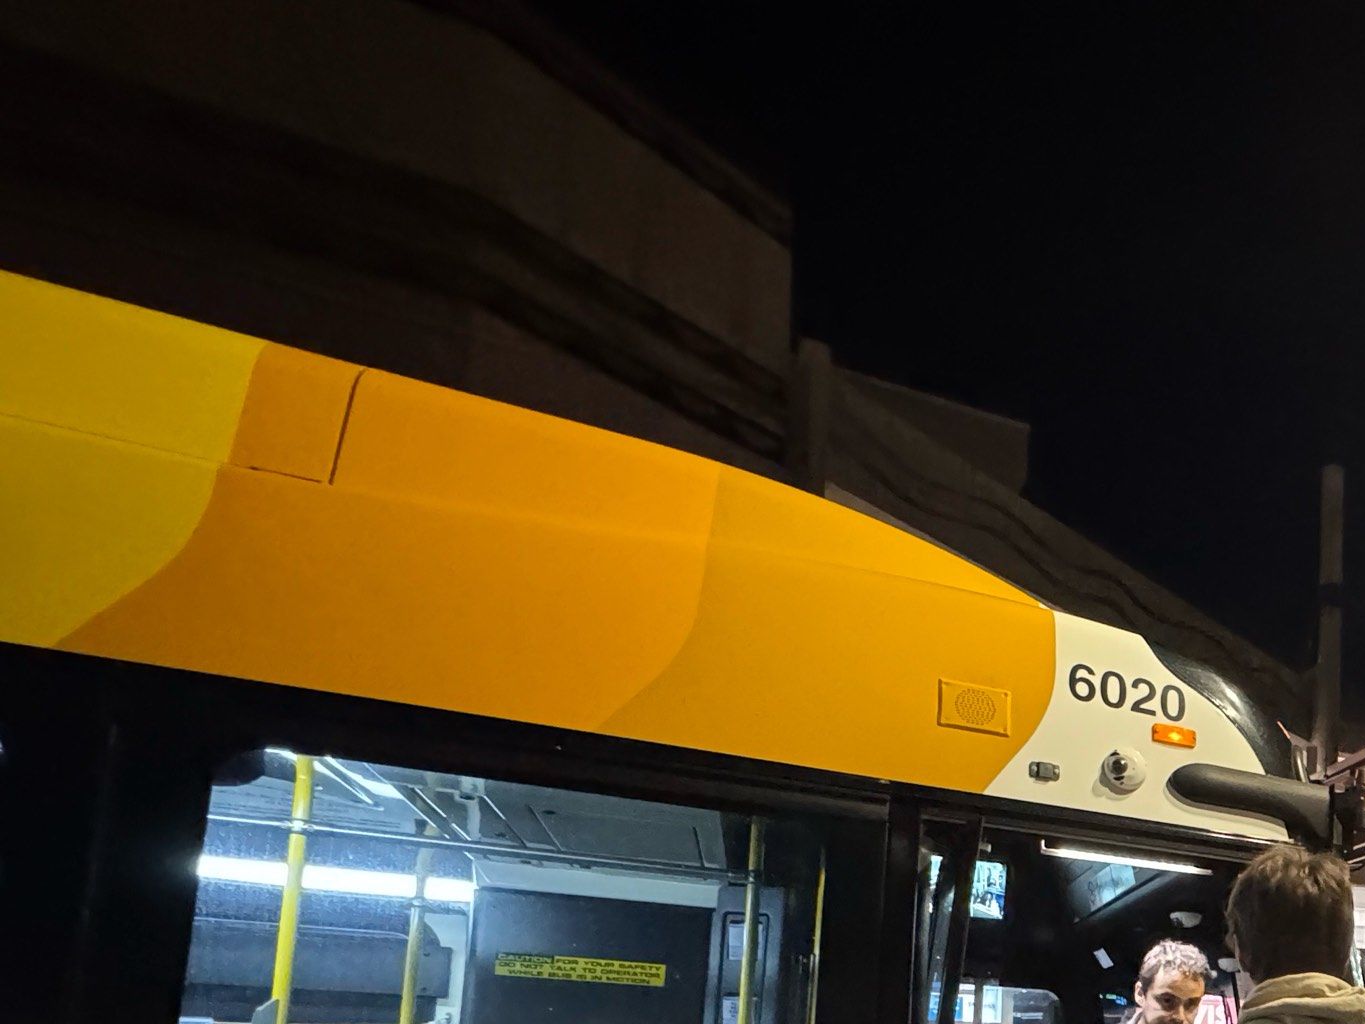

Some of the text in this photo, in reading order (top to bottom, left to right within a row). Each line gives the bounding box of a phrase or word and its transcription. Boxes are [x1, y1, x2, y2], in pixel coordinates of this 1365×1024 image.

[1068, 663, 1185, 722] 6020
[498, 953, 553, 964] CAUTION
[584, 960, 614, 968] YOUR
[619, 963, 661, 971] SAFETY
[508, 969, 543, 977] WHILE
[606, 976, 650, 985] MOTION
[550, 965, 577, 973] TALK
[600, 968, 660, 978] OPERATOR
